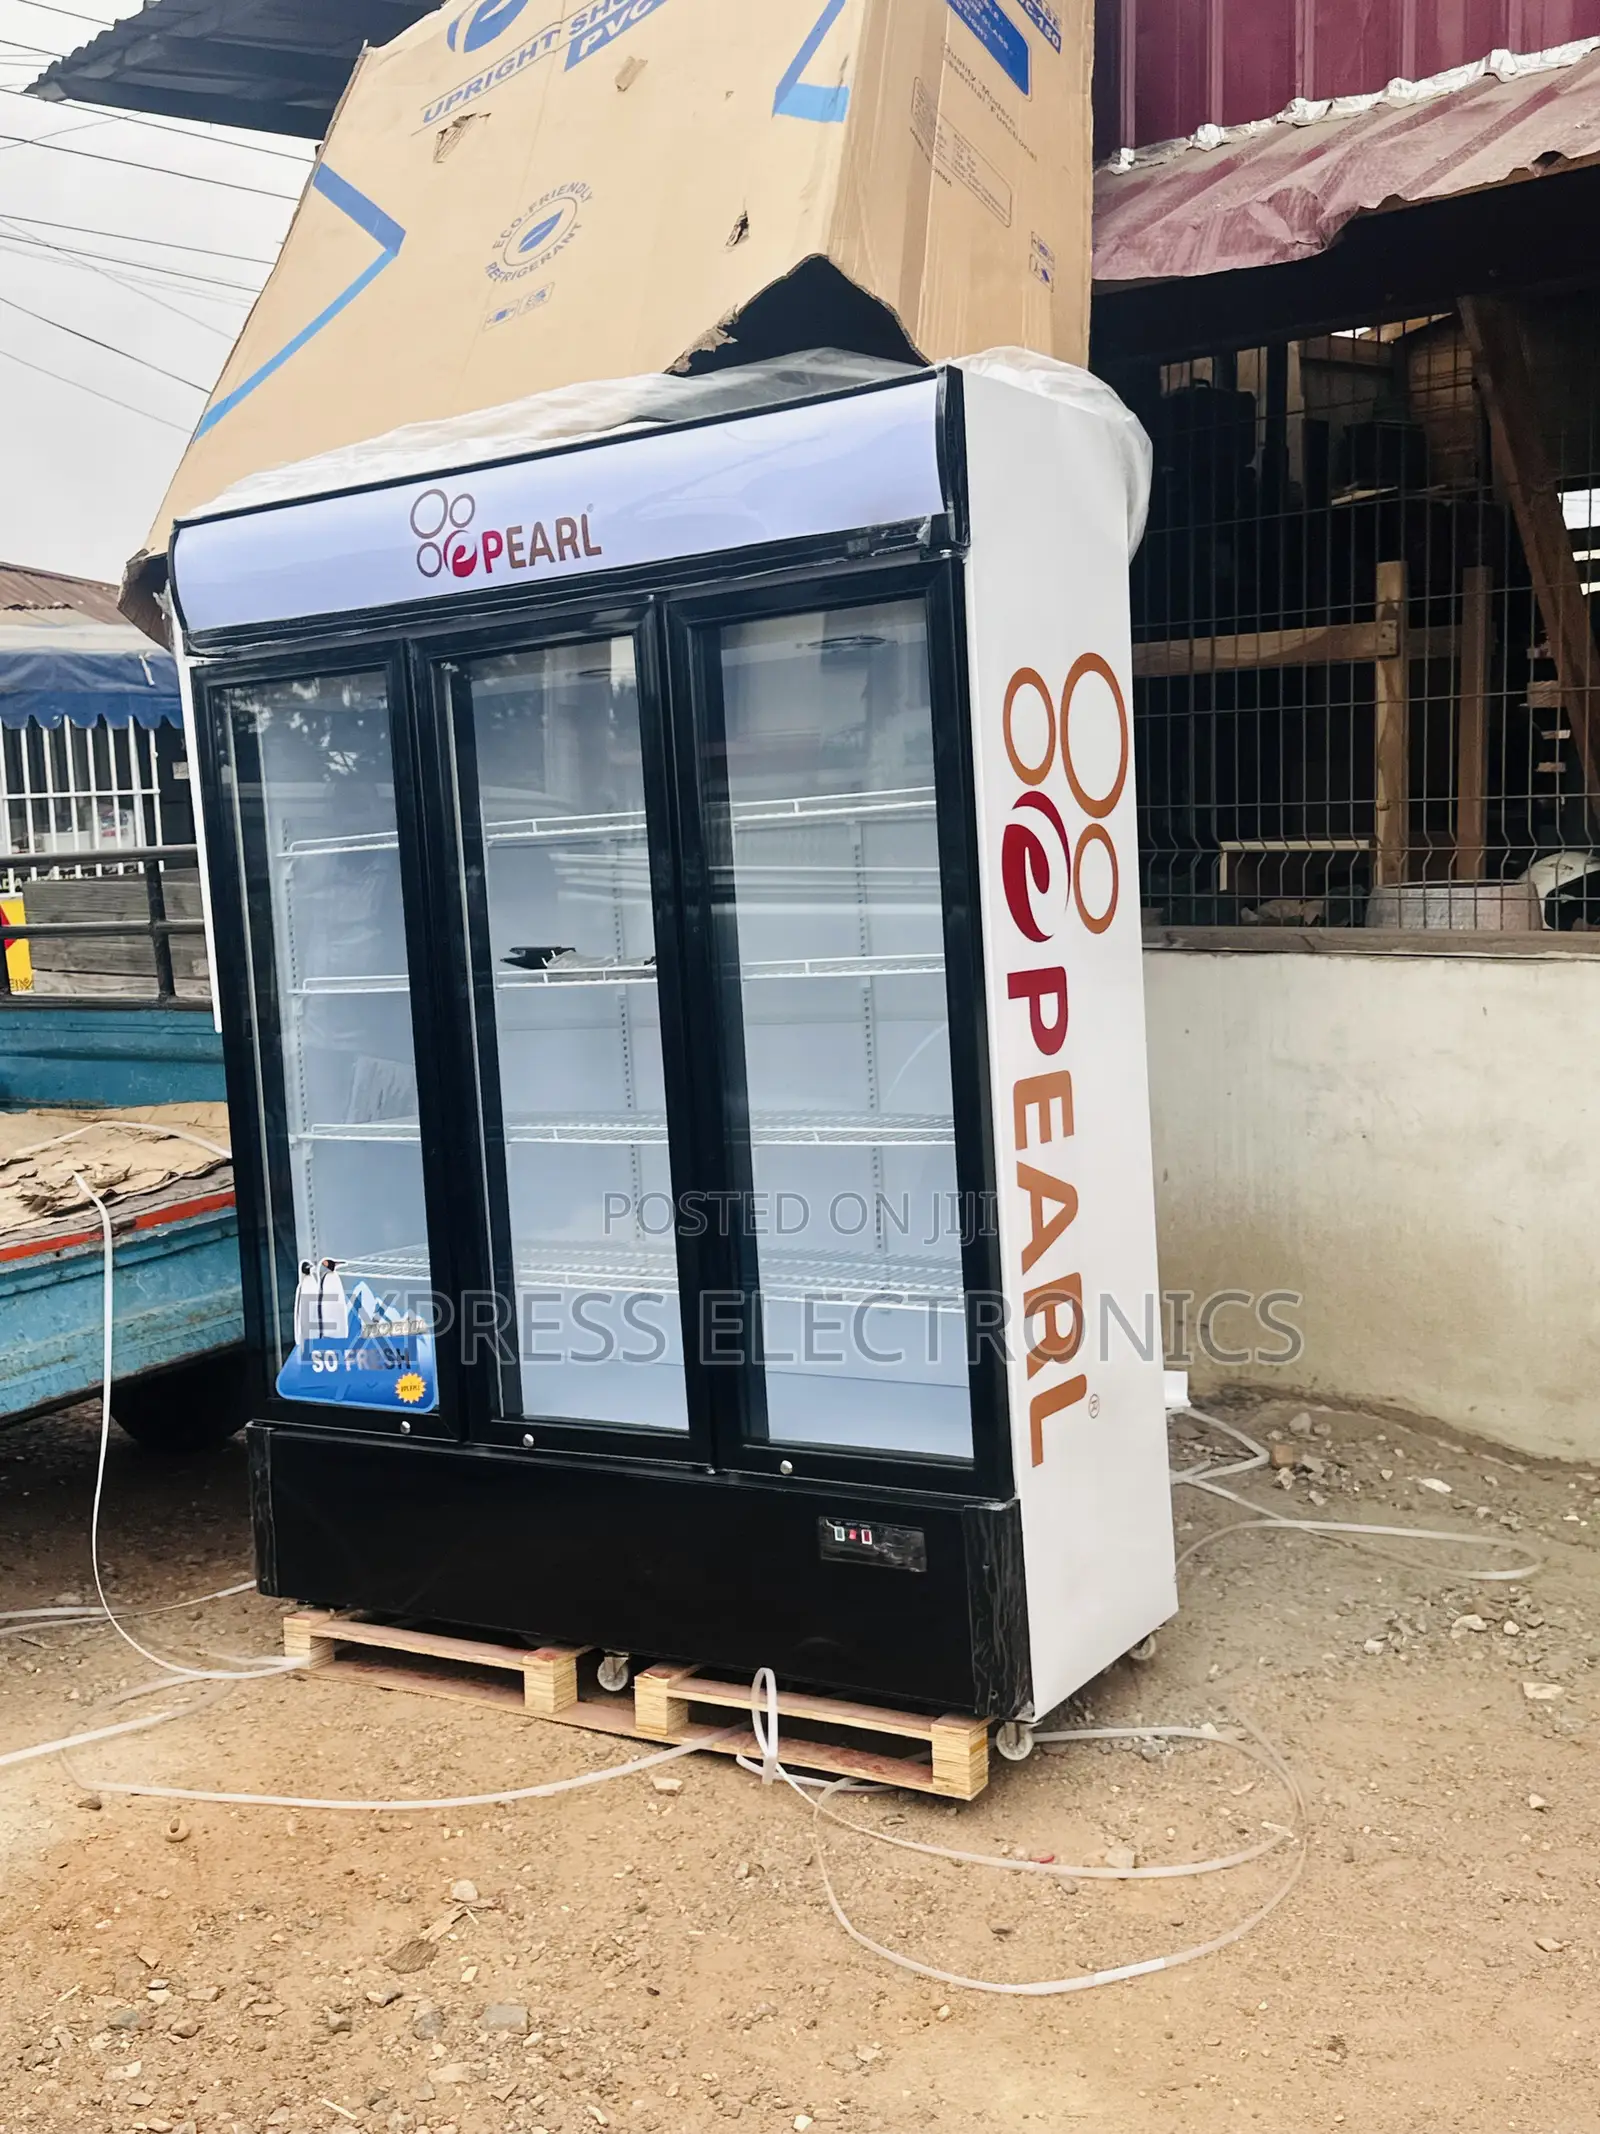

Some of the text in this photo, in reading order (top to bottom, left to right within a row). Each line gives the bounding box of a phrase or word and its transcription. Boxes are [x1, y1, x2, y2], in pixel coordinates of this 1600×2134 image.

[578, 0, 654, 57] PVC
[1018, 0, 1060, 49] C-150
[423, 0, 632, 123] UPRIGHT SH
[944, 58, 985, 103] ssential
[492, 181, 593, 250] ECO-FRIENDLY
[484, 222, 582, 285] REFRIGERANT
[311, 1349, 338, 1373] SO
